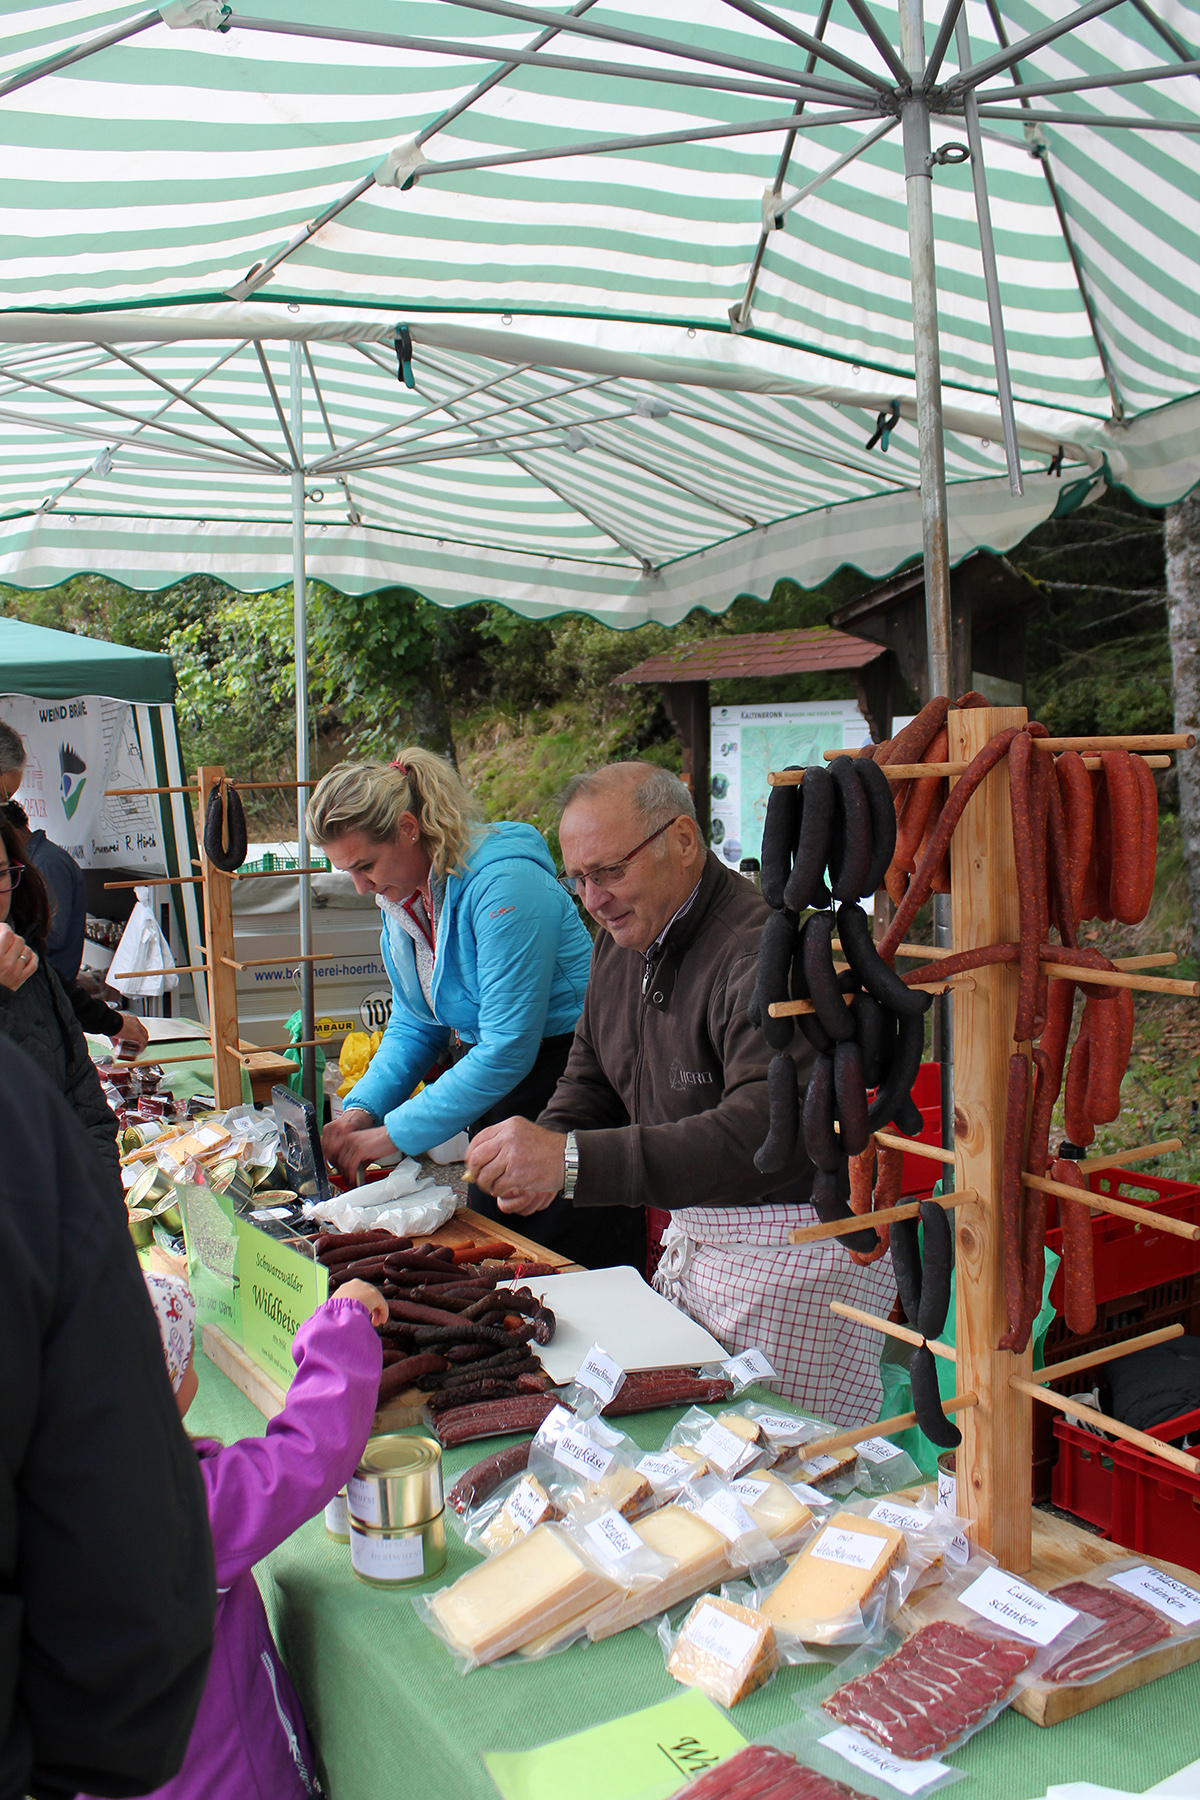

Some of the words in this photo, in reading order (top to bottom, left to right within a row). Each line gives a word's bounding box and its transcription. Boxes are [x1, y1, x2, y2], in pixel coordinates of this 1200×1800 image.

[314, 1022, 353, 1032] MBAUR
[255, 1252, 304, 1293] Schwarzwälder
[561, 1437, 606, 1470] Bergkäse
[643, 1459, 681, 1476] Bergkäs
[876, 1508, 924, 1529] Bergkäse
[1139, 1582, 1186, 1609] schinken
[988, 1599, 1038, 1627] schinken
[848, 1744, 901, 1773] schinken
